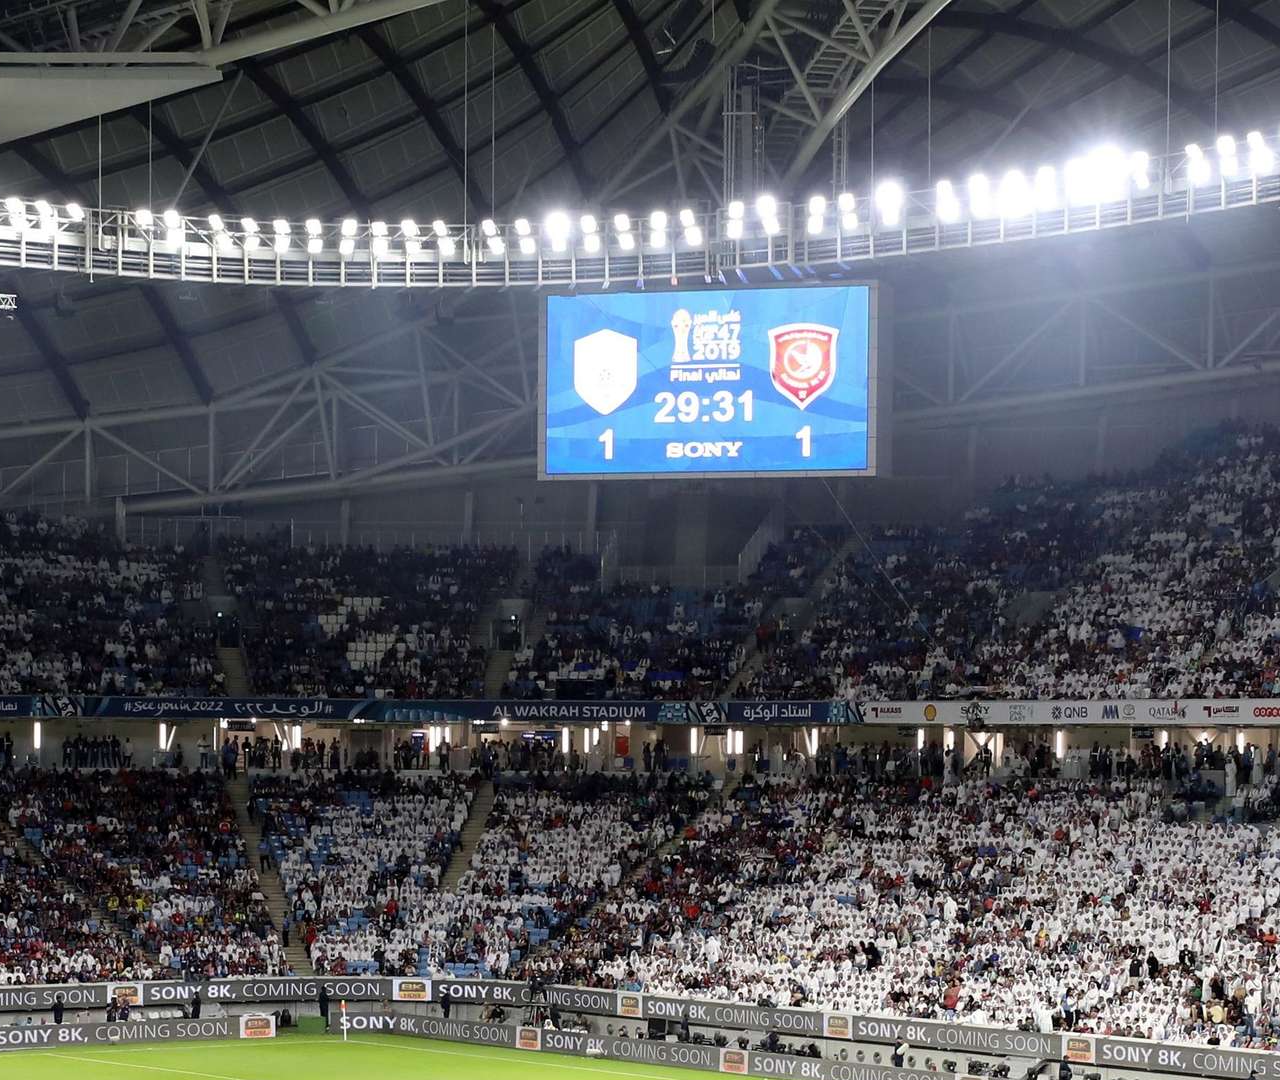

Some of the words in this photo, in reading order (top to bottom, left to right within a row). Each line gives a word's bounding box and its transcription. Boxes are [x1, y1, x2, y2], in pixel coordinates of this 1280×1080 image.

[670, 369, 703, 382] Final
[654, 390, 754, 424] 29:31
[598, 428, 614, 460] 1
[666, 442, 743, 458] SONY
[796, 426, 812, 457] 1
[492, 705, 512, 716] AL
[514, 706, 580, 718] WAKRAH
[582, 706, 646, 718] STADIUM
[744, 703, 777, 720] الوكرة
[780, 704, 810, 718] استاد
[1064, 707, 1088, 719] QNB
[150, 986, 202, 1000] SONY
[207, 984, 236, 998] 8K,
[242, 982, 317, 998] COMING
[326, 982, 385, 997] SOON.
[438, 984, 488, 998] SONY
[492, 988, 516, 1002] 8K,
[574, 993, 613, 1011] SOON.
[648, 1002, 684, 1018] SONY
[688, 1006, 711, 1022] 8K,
[714, 1008, 770, 1026] COMING
[774, 1012, 818, 1031] SOON.
[58, 1028, 88, 1043] 8K,
[96, 1024, 170, 1041] COMING
[176, 1020, 232, 1036] SOON.
[400, 1017, 418, 1034] 8K,
[422, 1020, 470, 1038] COMING
[472, 1026, 512, 1043] SOON.
[858, 1021, 902, 1040] SONY
[907, 1026, 930, 1043] 8K,
[936, 1028, 999, 1048] COMING
[1006, 1035, 1055, 1054] SOON.
[546, 1034, 584, 1051] SONY
[612, 1042, 666, 1061] COMING
[670, 1047, 714, 1066] SOON.
[1102, 1044, 1152, 1066] SONY
[1158, 1050, 1186, 1068] 8K,
[1192, 1054, 1266, 1076] COMING
[754, 1056, 796, 1077] SONY
[801, 1060, 824, 1080] 8K,
